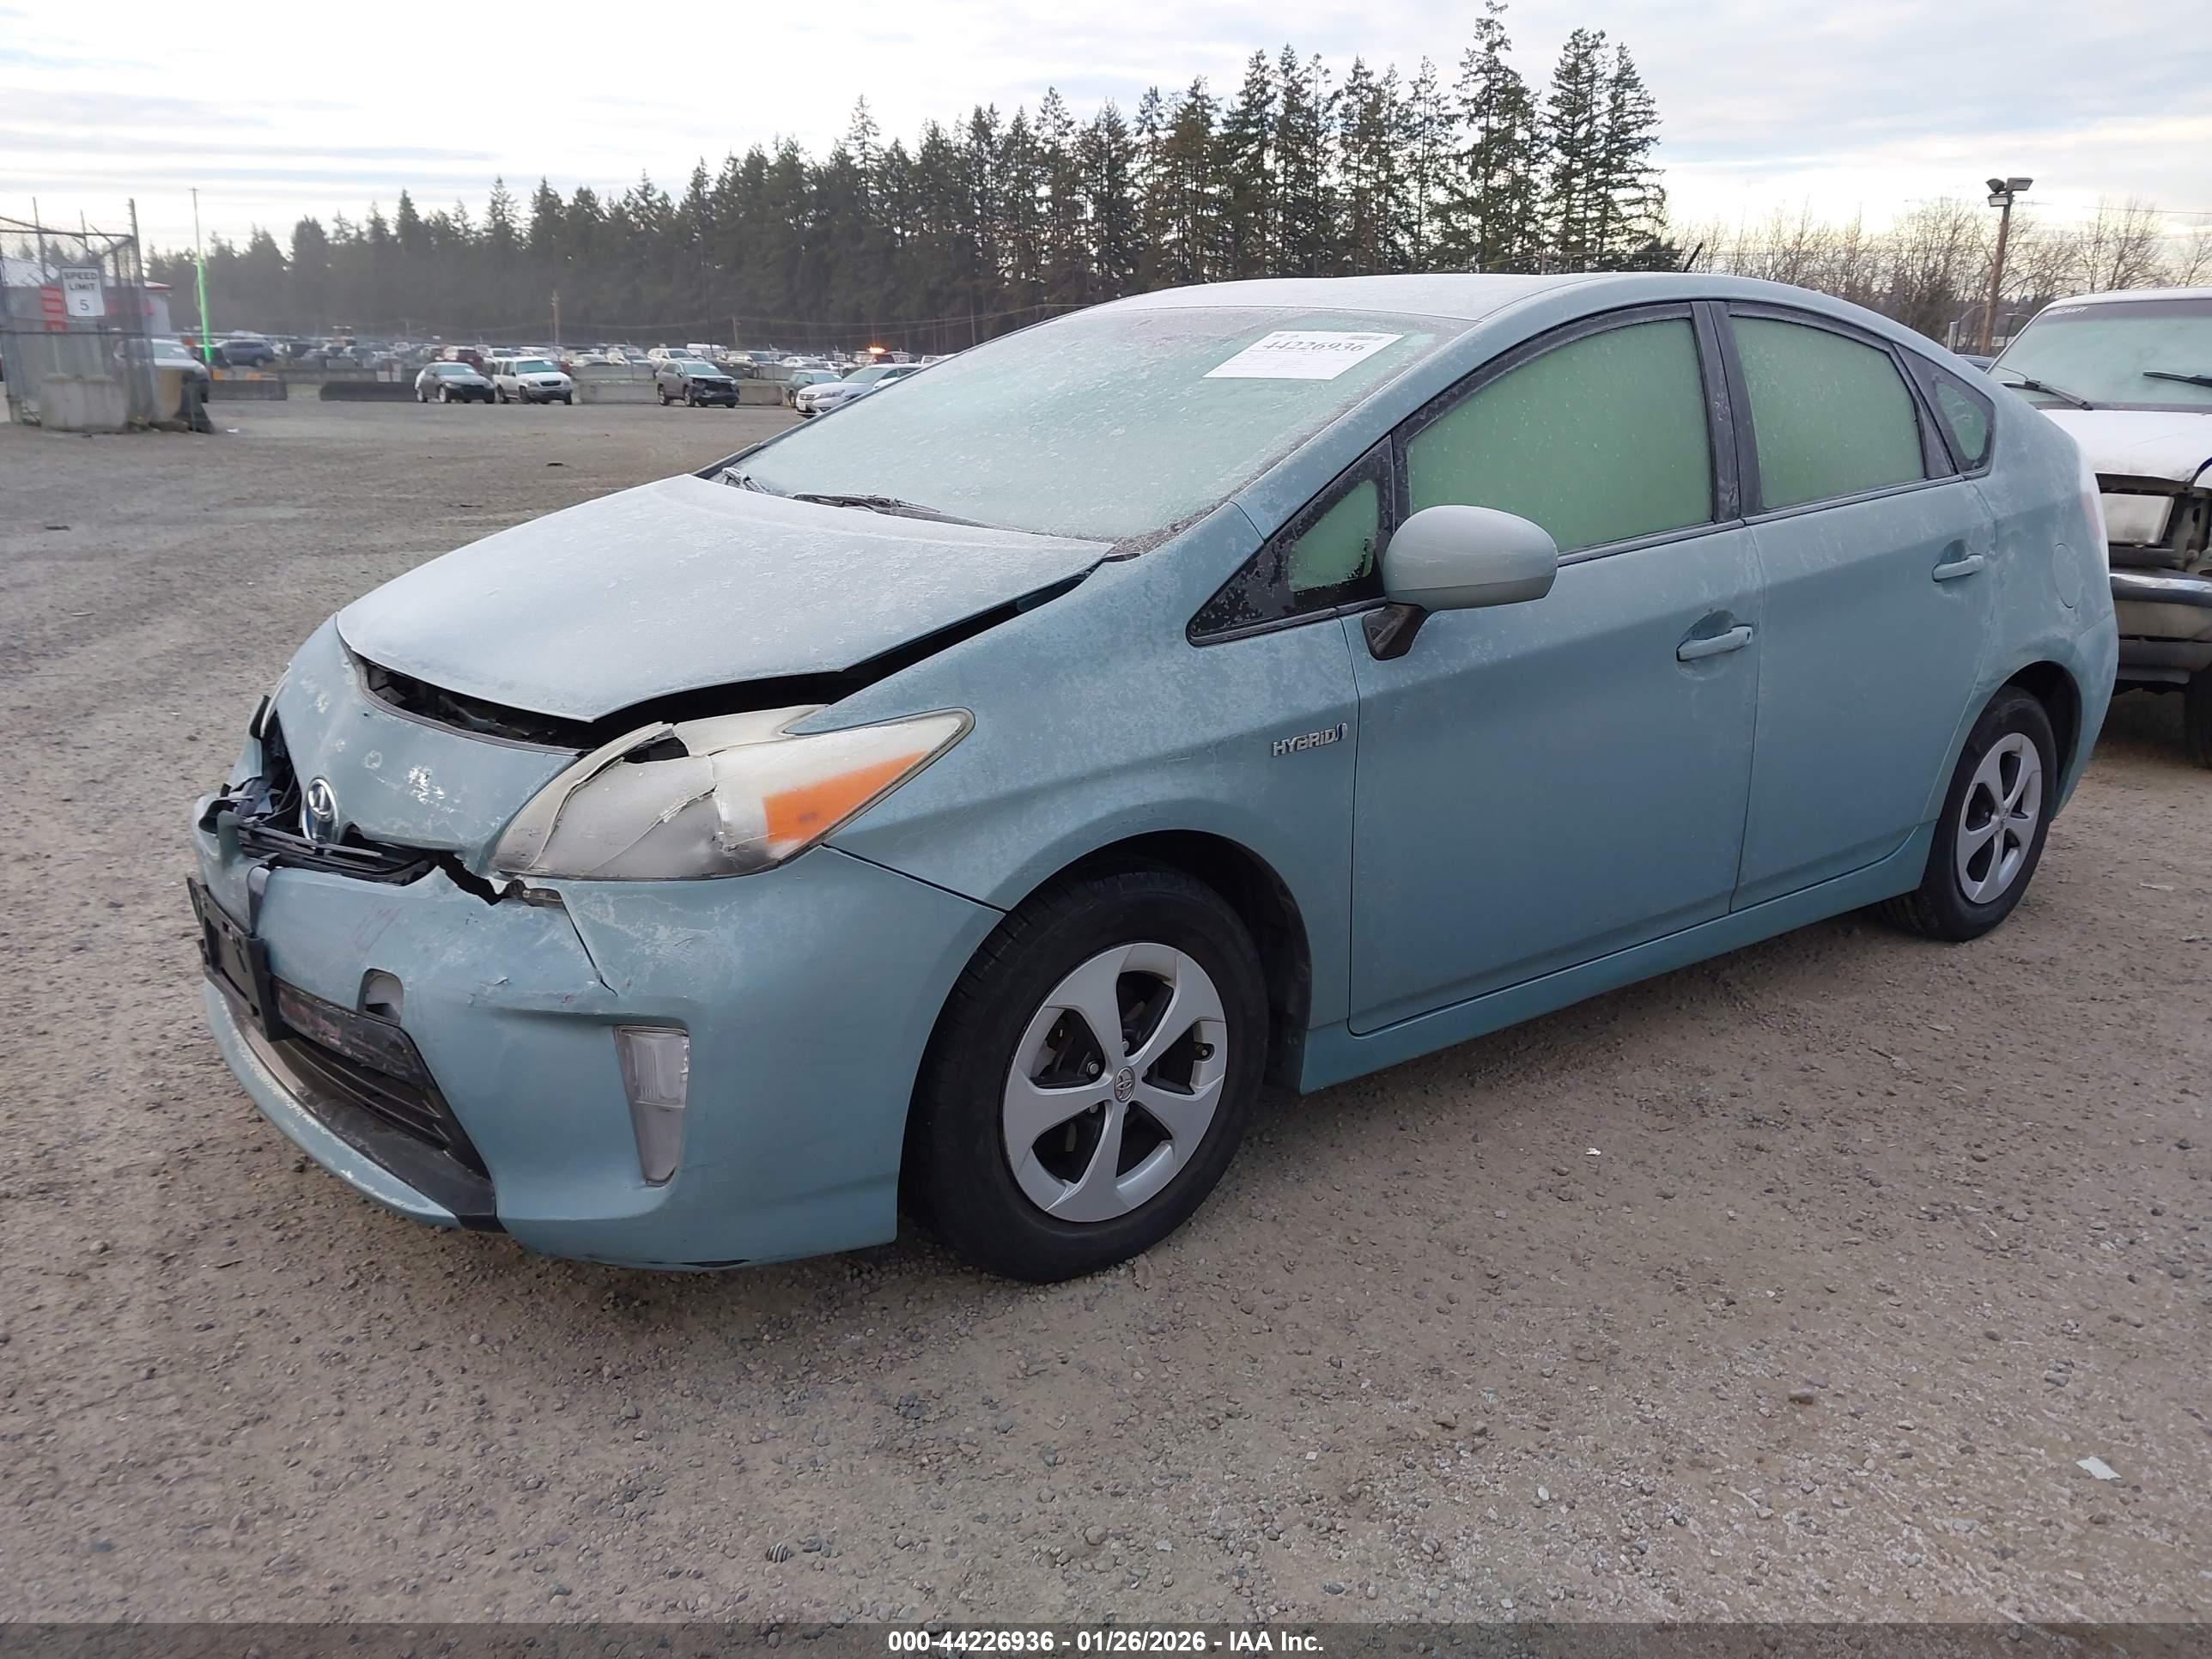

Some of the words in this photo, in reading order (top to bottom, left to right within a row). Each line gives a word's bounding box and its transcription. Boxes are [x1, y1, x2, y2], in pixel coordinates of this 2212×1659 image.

[64, 271, 97, 280] SPEED
[79, 299, 89, 311] 5
[1263, 340, 1367, 352] 44226936
